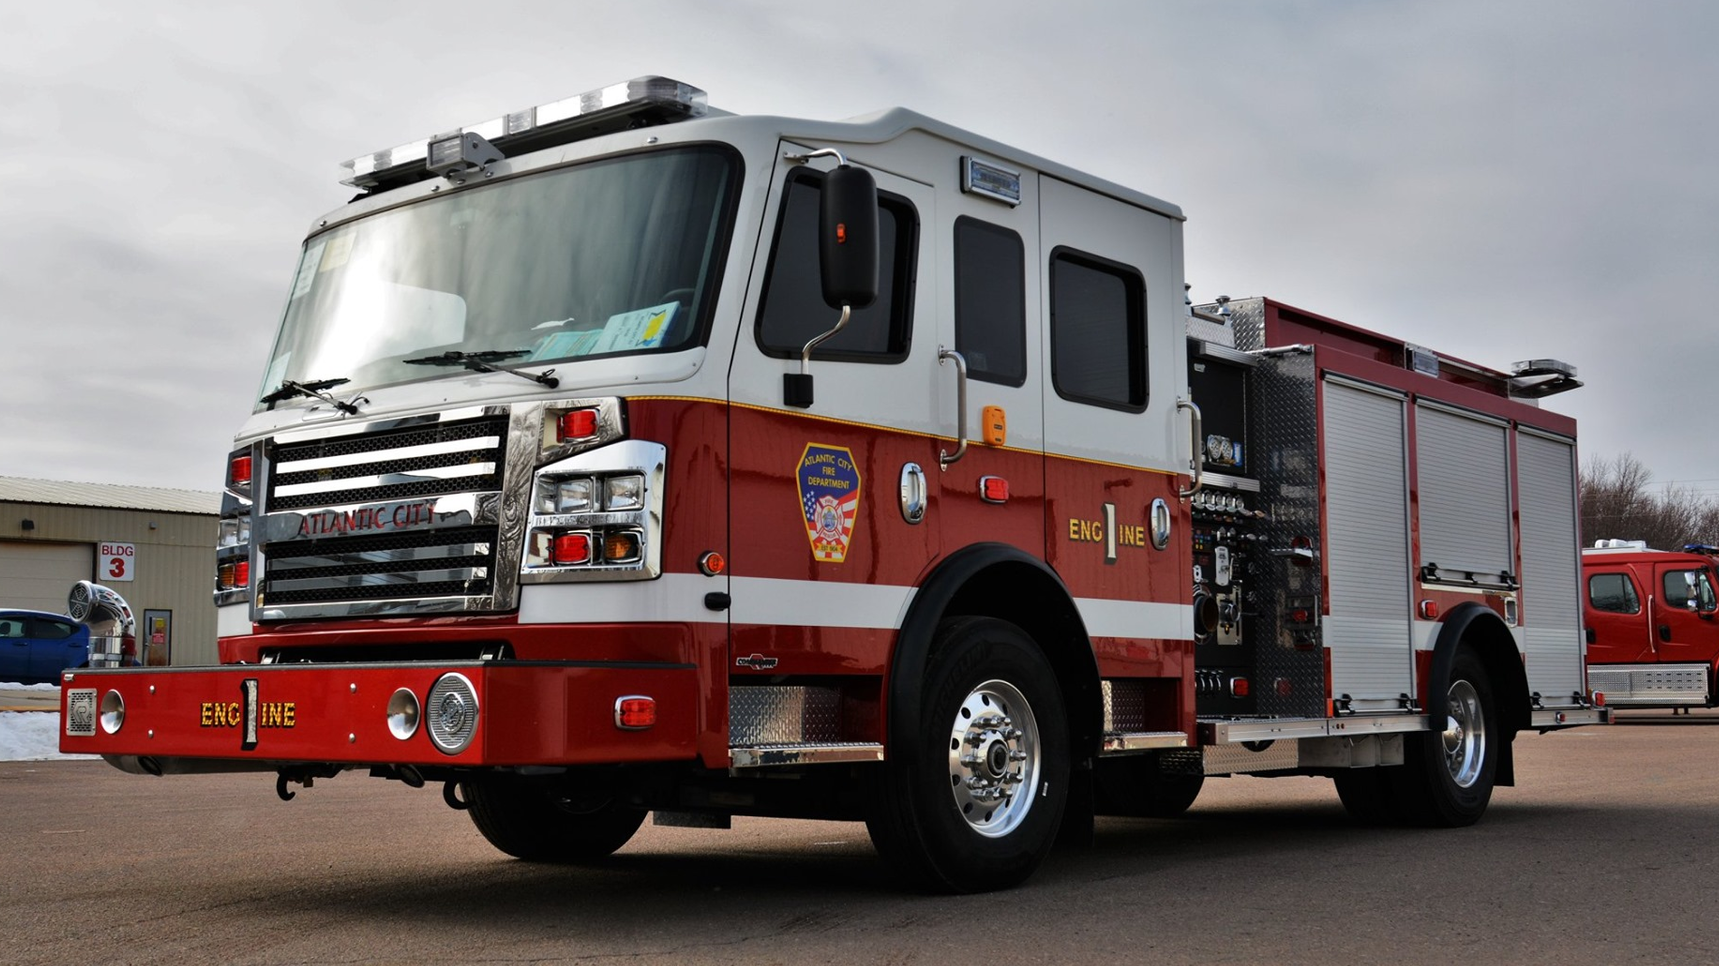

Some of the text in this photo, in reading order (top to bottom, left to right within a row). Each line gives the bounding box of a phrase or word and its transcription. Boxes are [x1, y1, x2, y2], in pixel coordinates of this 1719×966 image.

[805, 454, 852, 471] ATLANTIC CITY
[822, 466, 836, 476] FIRE
[808, 476, 850, 489] DEPARTMENT
[298, 502, 436, 536] ATLANTIC CITY
[101, 545, 134, 557] BLDG
[109, 557, 125, 578] 3
